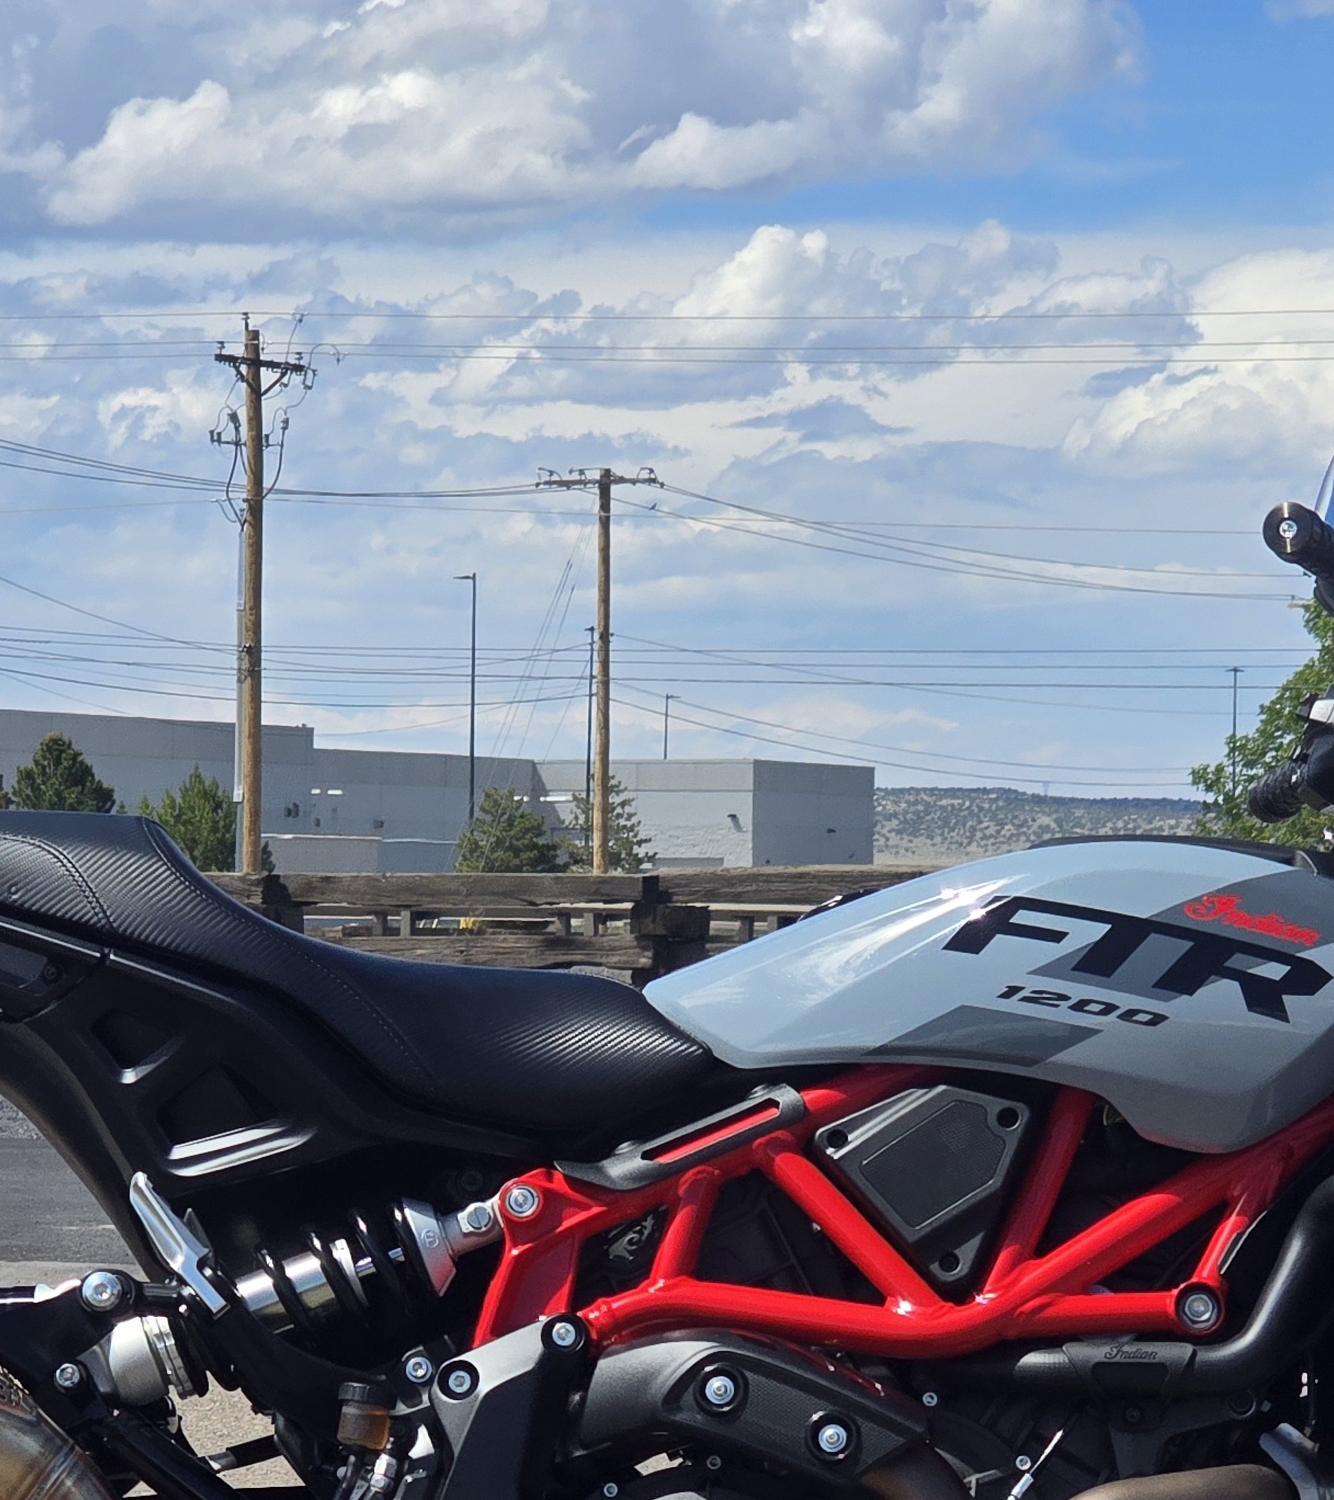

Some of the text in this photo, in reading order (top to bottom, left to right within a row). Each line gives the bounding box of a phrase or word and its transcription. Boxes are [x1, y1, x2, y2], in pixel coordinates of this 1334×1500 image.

[1184, 895, 1320, 946] Indian
[942, 895, 1334, 1024] FTR
[996, 985, 1169, 1027] 1200
[1104, 1343, 1158, 1360] Indian
